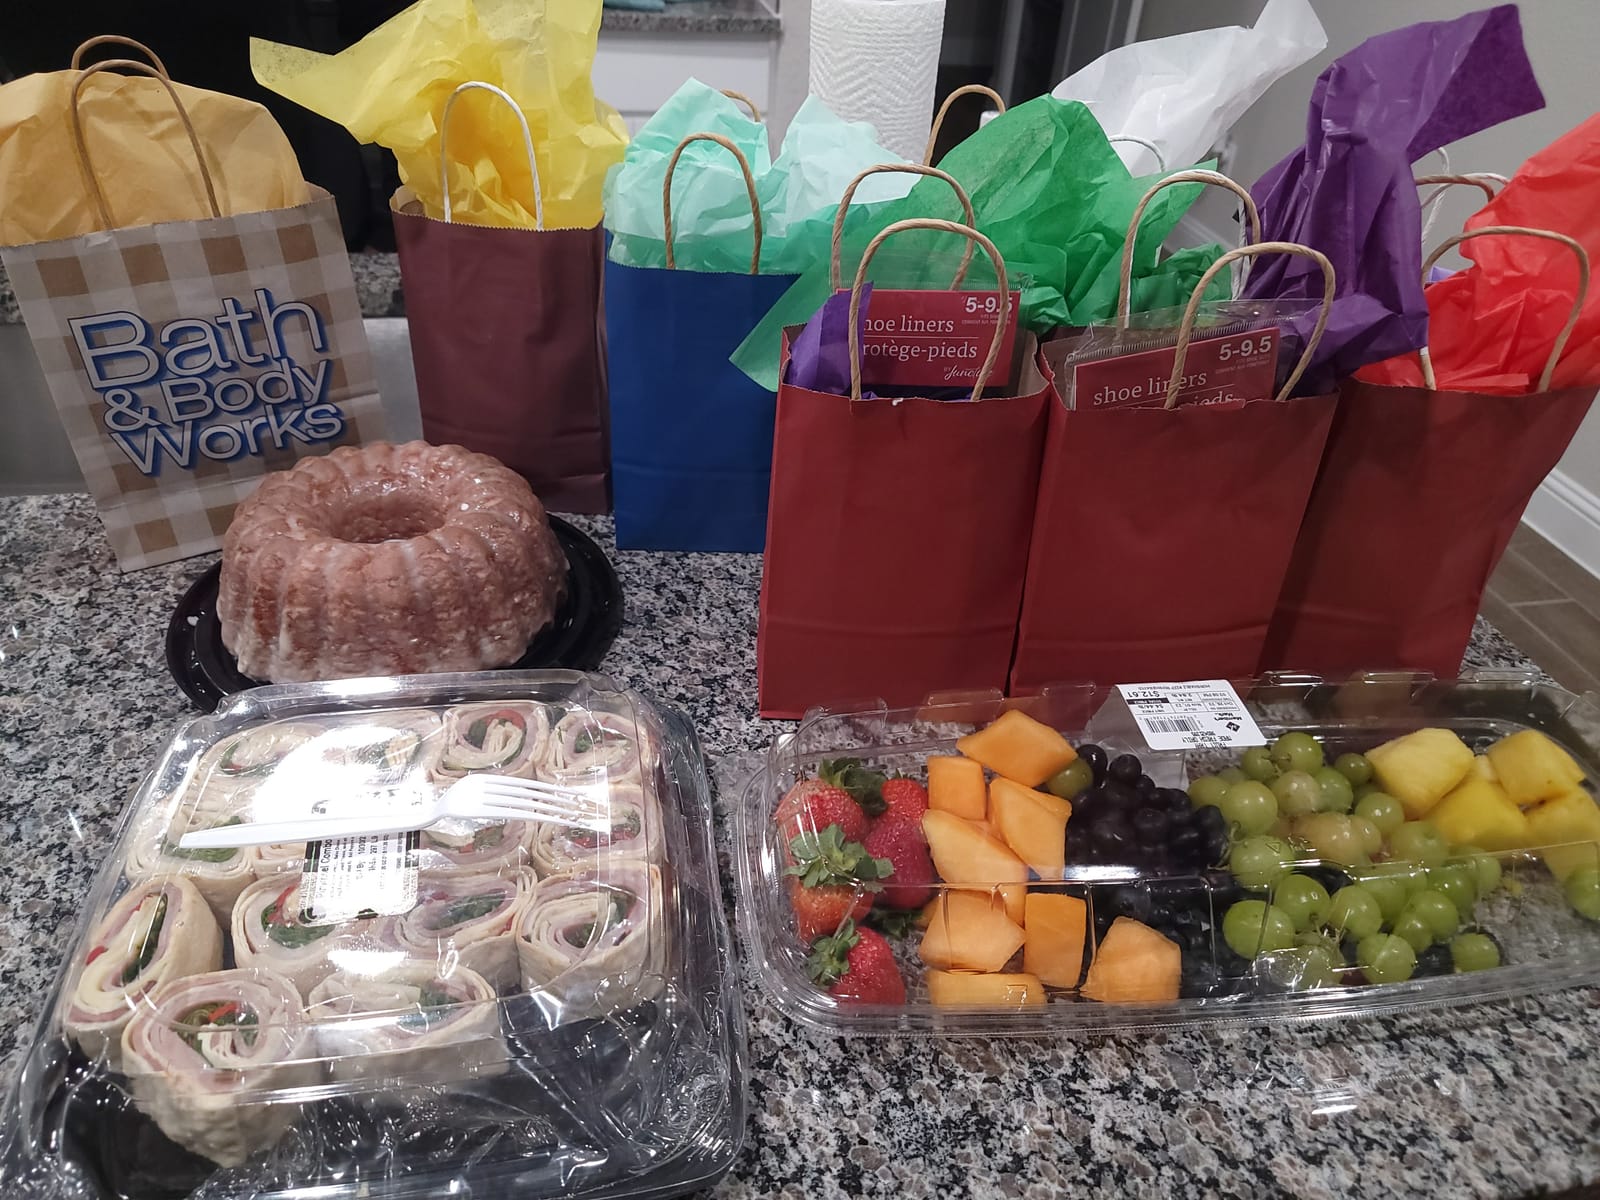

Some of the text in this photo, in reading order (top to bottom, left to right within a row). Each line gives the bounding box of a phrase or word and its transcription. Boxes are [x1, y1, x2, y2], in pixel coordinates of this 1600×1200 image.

[900, 314, 954, 332] liners
[68, 288, 330, 390] Bath
[863, 339, 978, 362] rotège-pieds
[1219, 335, 1272, 361] 5-9.5
[103, 357, 331, 434] & Body
[1093, 385, 1142, 406] shoe
[109, 403, 344, 477] Works
[1127, 690, 1160, 698] $12.61
